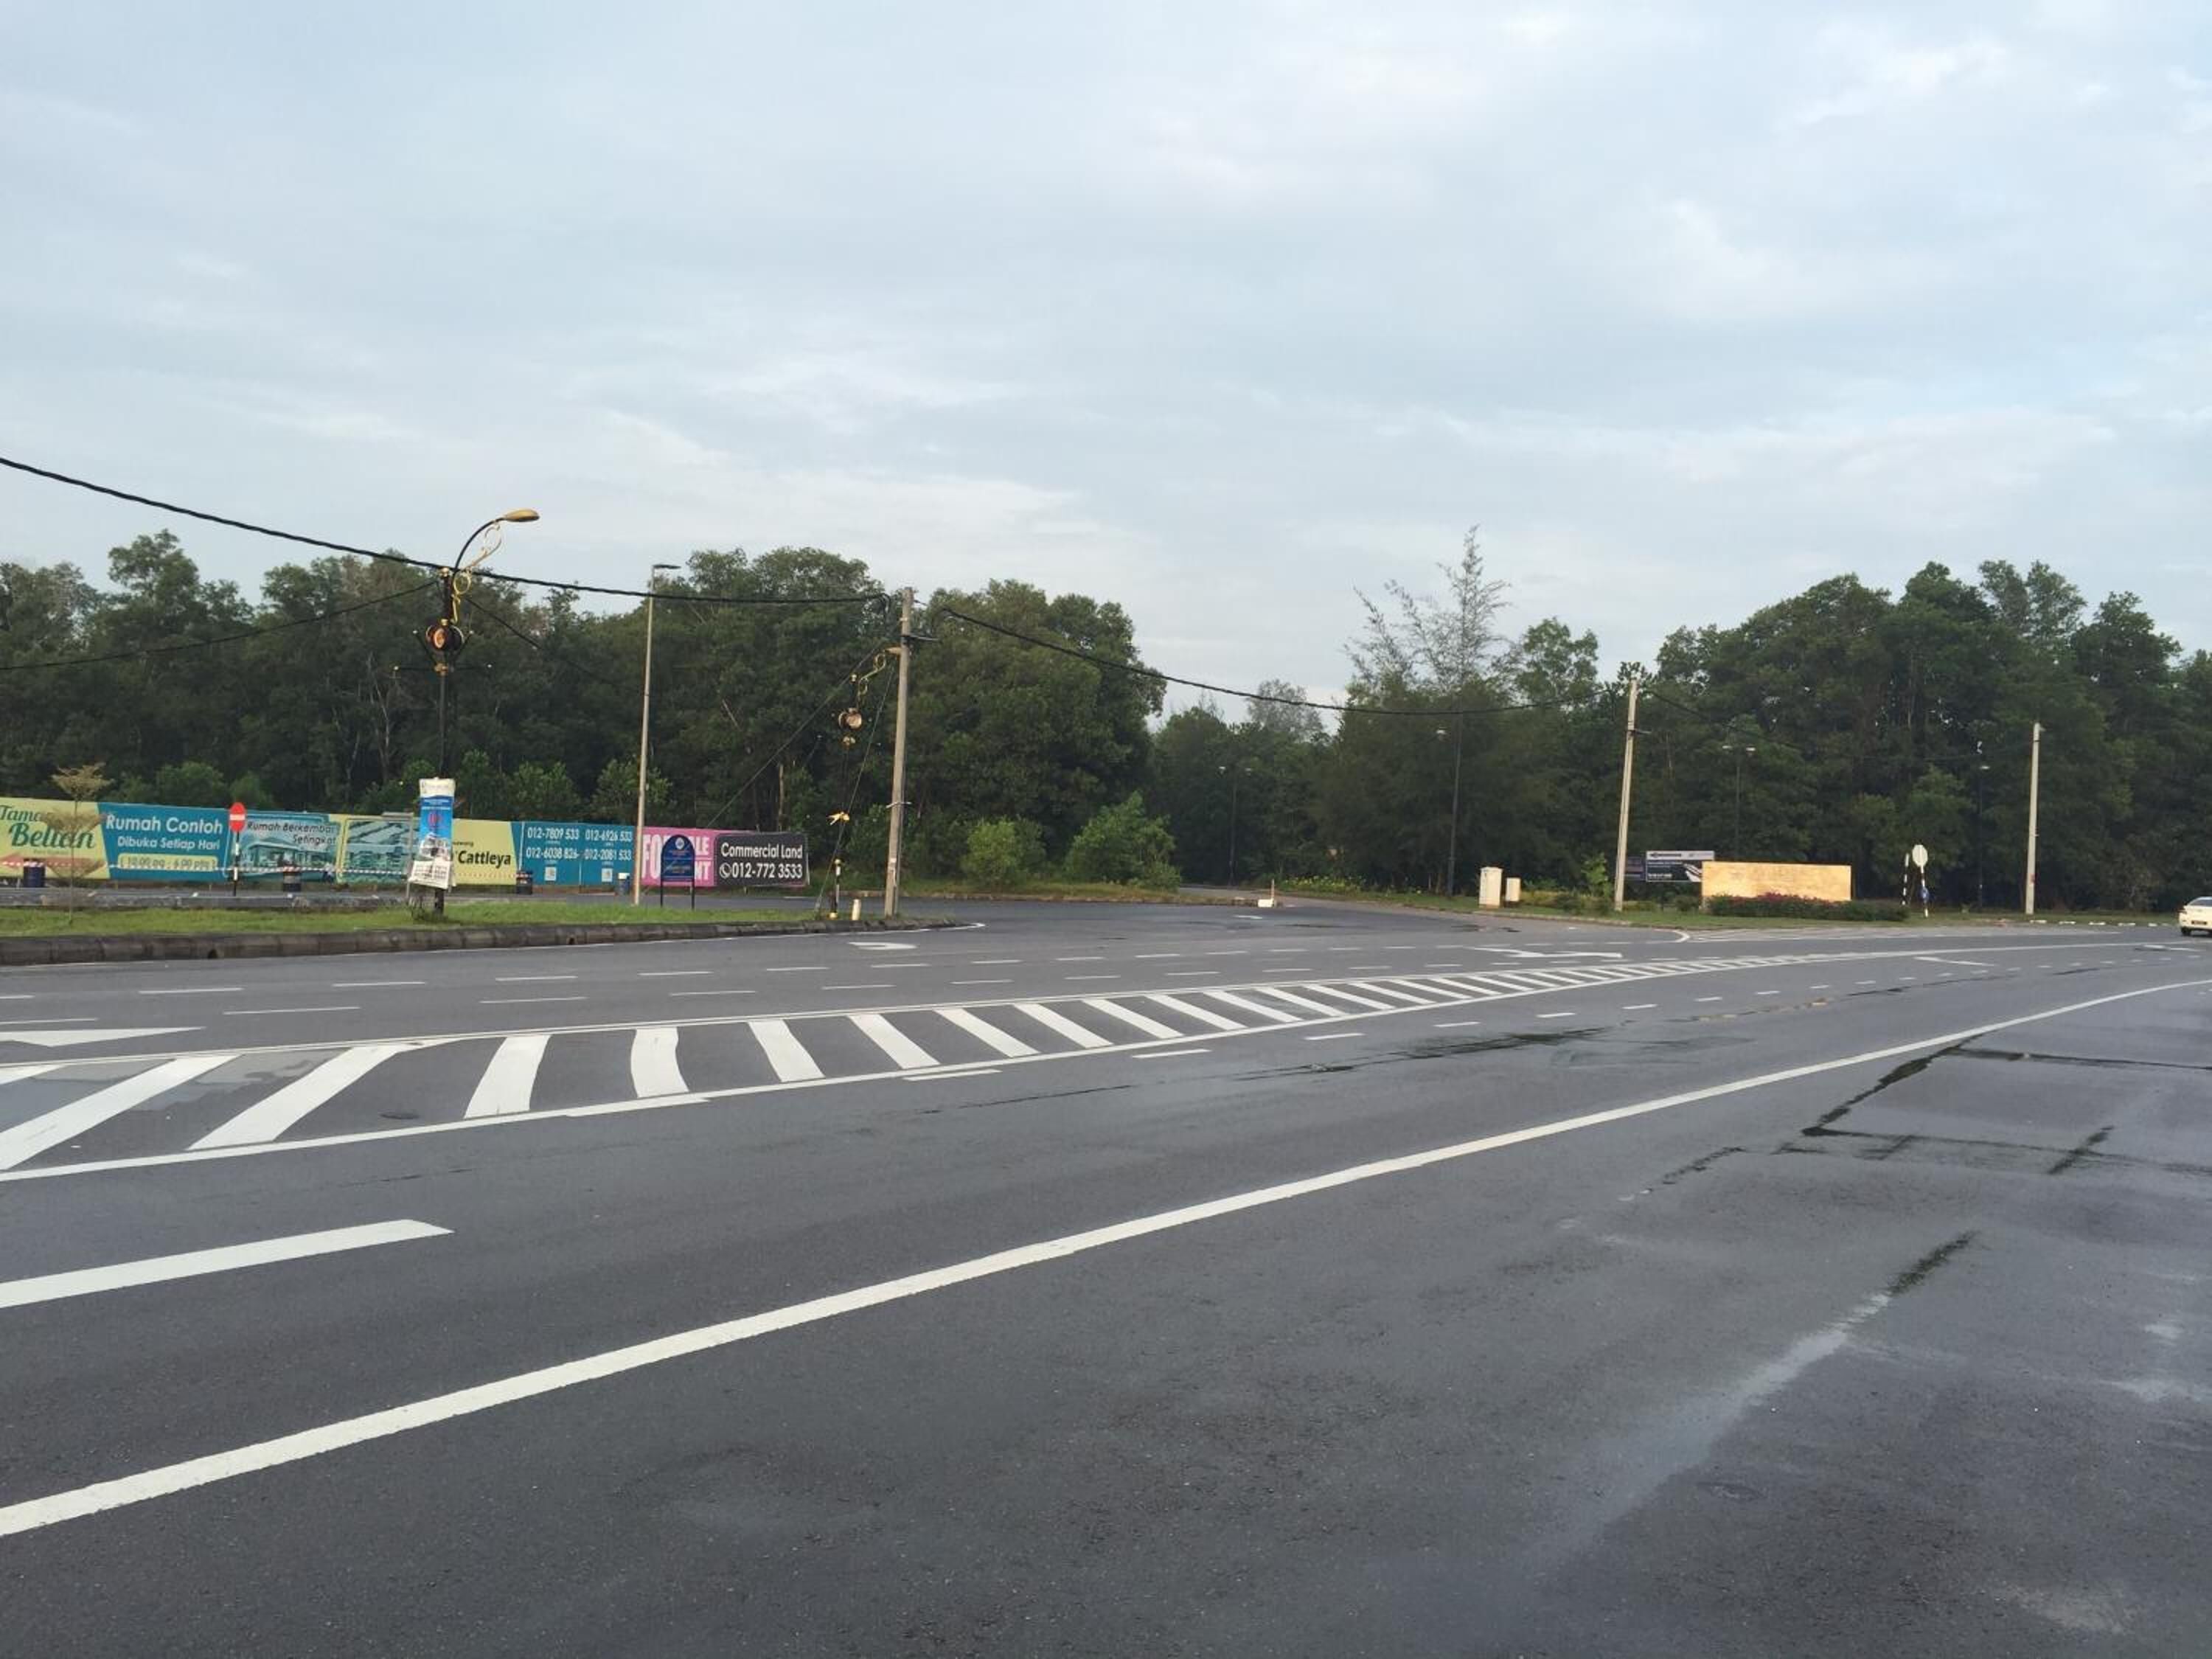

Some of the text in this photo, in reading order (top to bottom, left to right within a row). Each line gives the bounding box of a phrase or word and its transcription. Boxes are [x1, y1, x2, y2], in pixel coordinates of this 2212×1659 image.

[106, 814, 223, 834] Rumah Contoh
[248, 821, 280, 832] Rumah
[566, 829, 579, 840] 533
[117, 836, 220, 851] Dibuka Setiap Hari
[721, 842, 803, 859] Commercial Land
[642, 834, 667, 879] FO
[732, 862, 803, 878] 012-772 3533
